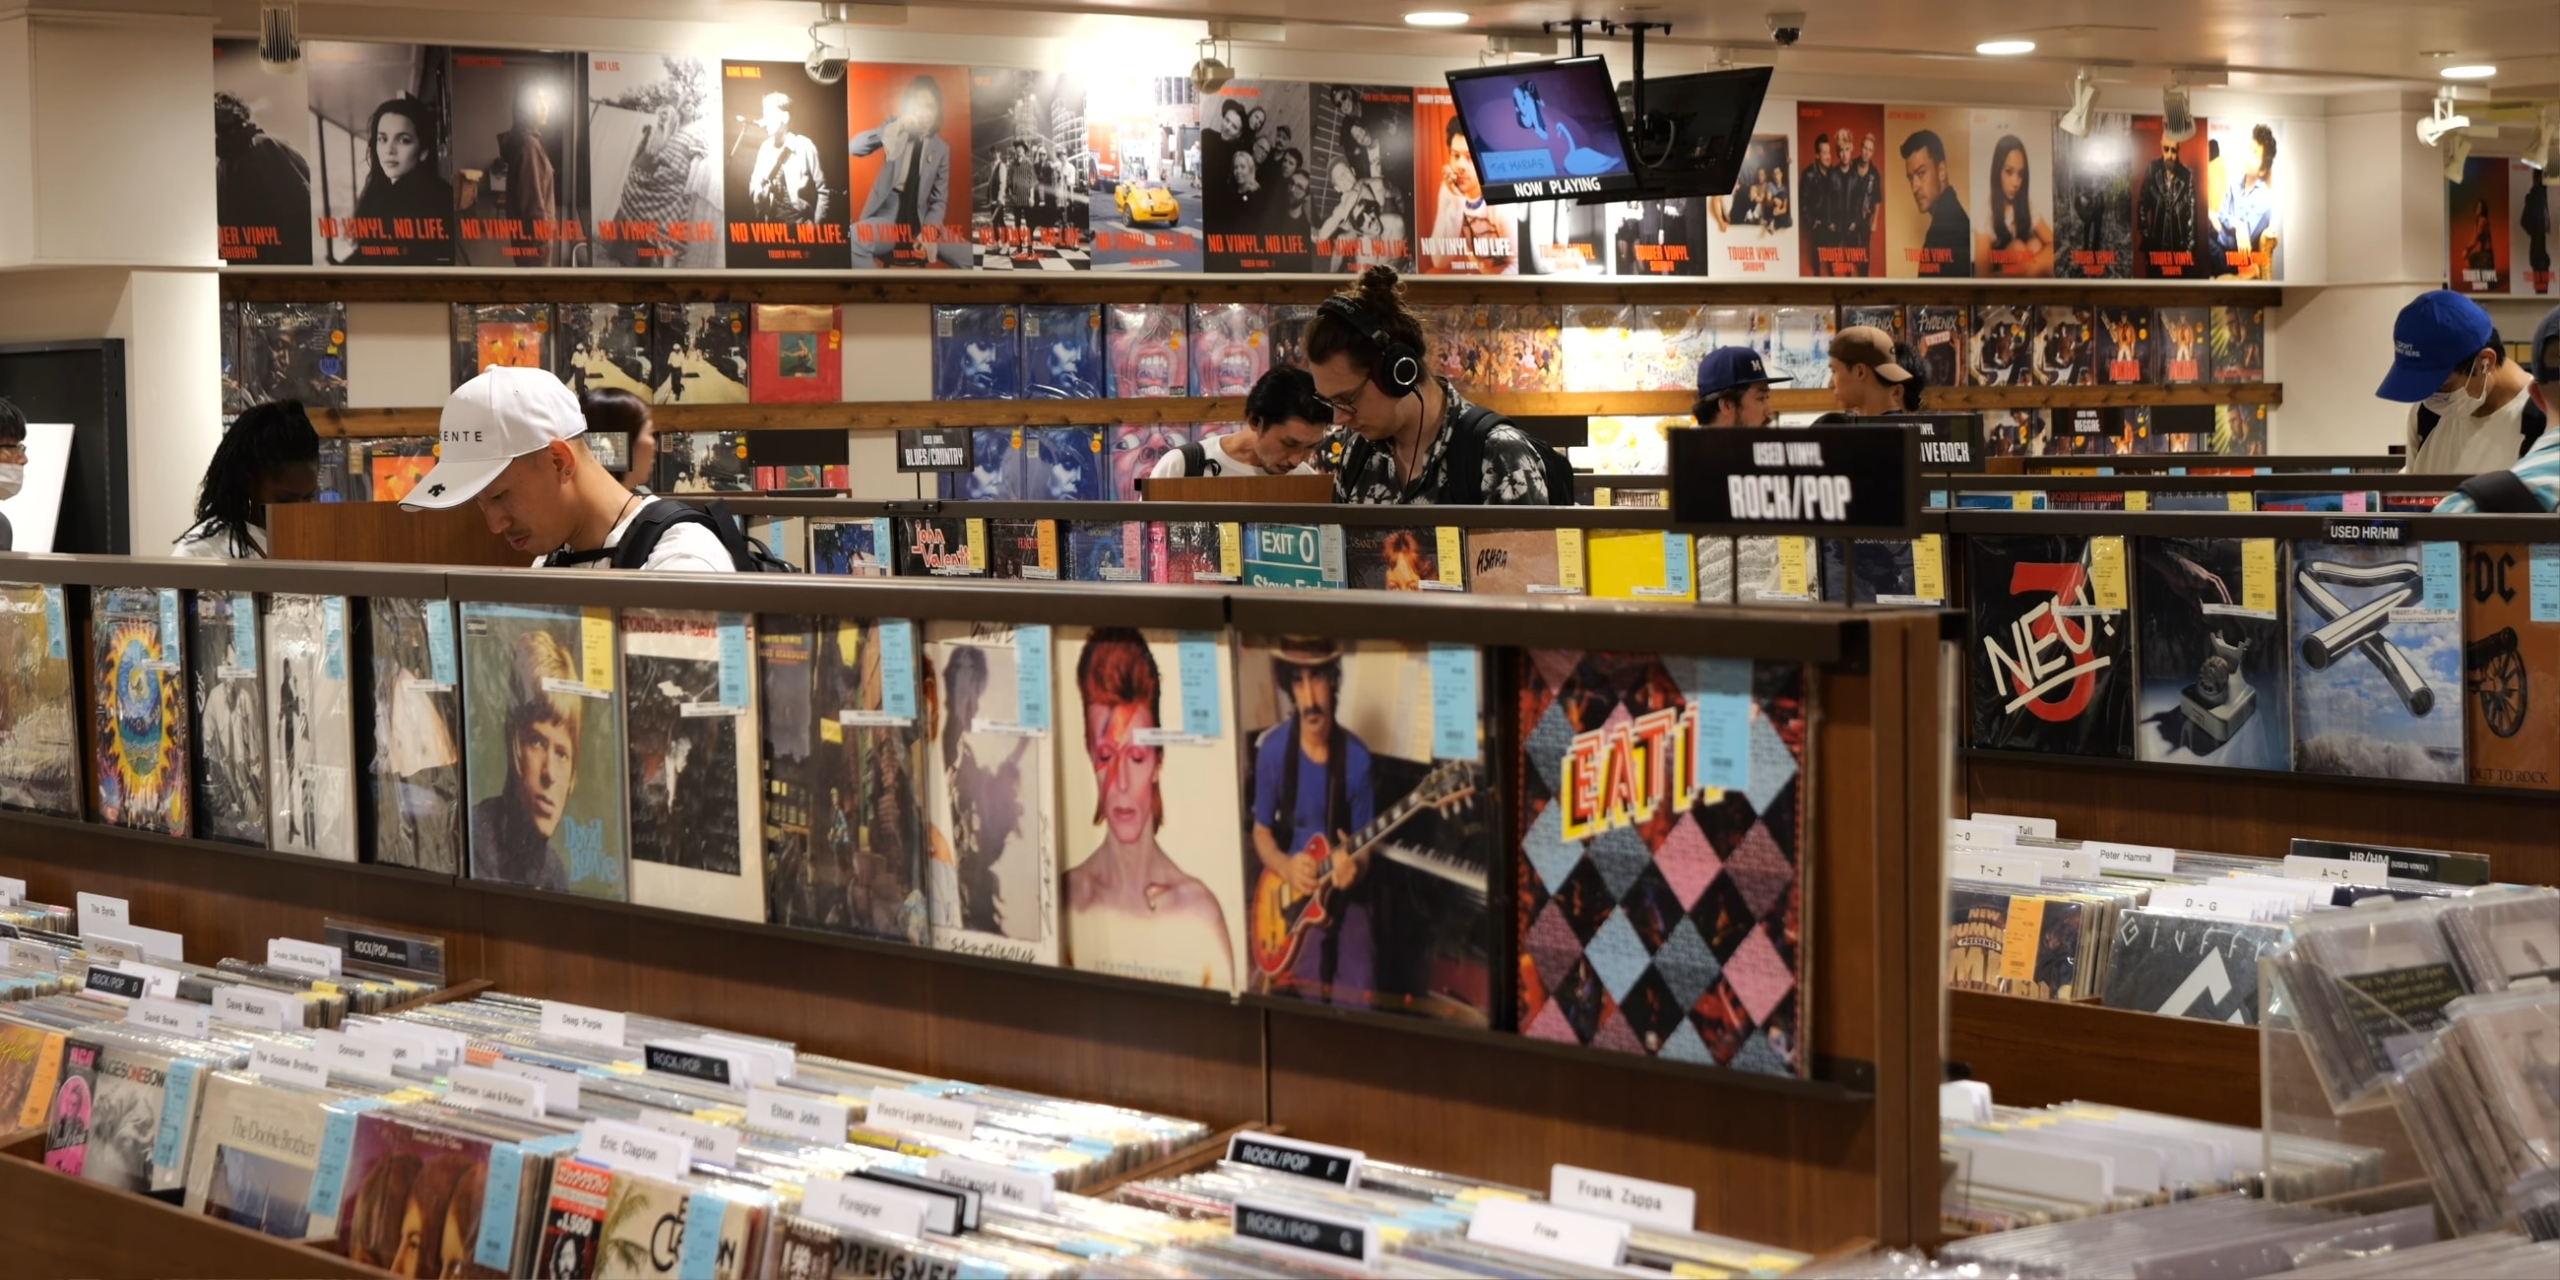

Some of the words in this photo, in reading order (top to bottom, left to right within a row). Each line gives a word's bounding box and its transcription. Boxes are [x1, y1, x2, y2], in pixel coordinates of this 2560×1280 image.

[1513, 181, 1543, 199] NOW
[1549, 176, 1602, 196] PLAYING
[242, 226, 281, 246] VINYL
[318, 217, 339, 238] NO
[342, 217, 392, 240] VINYL,
[393, 218, 416, 239] NO
[416, 218, 449, 240] LIFE.
[461, 219, 481, 240] NO
[533, 220, 551, 241] NO
[730, 222, 749, 243] NO
[751, 223, 796, 244] VINYL,
[797, 223, 815, 243] NO
[816, 223, 846, 244] LIFE.
[1207, 233, 1224, 253] NO
[1226, 234, 1264, 255] VINYL,
[1265, 234, 1283, 254] NO
[1283, 235, 1308, 254] LIFE.
[1421, 237, 1437, 255] NO
[1438, 238, 1473, 257] VINYL,
[1474, 238, 1489, 255] NO
[1489, 238, 1514, 256] LIFE.
[1635, 244, 1664, 261] TOWER
[1664, 245, 1690, 261] VINYL
[1727, 246, 1754, 261] TOWER
[1755, 247, 1780, 262] VINYL
[1818, 247, 1844, 262] TOWER
[1844, 247, 1869, 262] VINYL
[1904, 248, 1929, 262] TOWER
[1930, 248, 1954, 263] VINYL
[2150, 251, 2174, 266] TOWER
[2174, 251, 2194, 266] VINYL
[1918, 312, 1958, 332] PHOENIX
[905, 447, 964, 466] BLUES/COUNTRY
[1752, 441, 1785, 466] USED
[1785, 442, 1825, 467] VINYL
[1727, 474, 1853, 521] ROCK/POP
[2330, 525, 2360, 538] USED
[2362, 526, 2399, 540] HR/HM
[1261, 531, 1295, 555] EXIT
[2496, 768, 2513, 782] TO
[2515, 770, 2549, 784] ROCK
[563, 815, 603, 850] David
[2018, 825, 2033, 836] Tull
[570, 848, 621, 882] Bowie
[2100, 849, 2120, 861] Peter
[2123, 851, 2152, 863] Hammill
[2349, 851, 2389, 865] HR/HM
[91, 903, 100, 915] The
[101, 905, 116, 918] Byrds
[1968, 907, 2000, 922] NEW
[354, 940, 389, 958] ROCK/POP
[1961, 938, 2000, 951] PRESENTS
[90, 972, 125, 989] ROCK/POP
[132, 980, 139, 993] D
[226, 998, 242, 1011] Dave
[244, 1001, 266, 1016] Mason
[144, 1011, 161, 1024] David
[161, 1014, 179, 1027] Bowie
[561, 1013, 579, 1028] Deep
[581, 1016, 603, 1032] Purple
[255, 1049, 269, 1063] The
[269, 1053, 291, 1069] Doobie
[291, 1057, 319, 1074] Brothers
[652, 1051, 702, 1073] ROCK/POP
[713, 1063, 722, 1077] E
[232, 1115, 248, 1134] The
[770, 1105, 794, 1121] Elton
[798, 1111, 821, 1127] John
[877, 1104, 903, 1121] Electric
[905, 1111, 925, 1127] Light
[925, 1115, 965, 1132] Orchestra
[600, 1135, 618, 1152] Eric
[621, 1140, 658, 1161] Clapton
[1242, 1144, 1310, 1172] ROCK/POP
[1327, 1161, 1338, 1178] F
[1001, 1185, 1025, 1203] Mac
[1577, 1179, 1614, 1202] Frank
[1620, 1187, 1664, 1212] Zappa
[838, 1193, 884, 1219] Foreigner
[1245, 1211, 1320, 1245] ROCK/POP
[1340, 1233, 1353, 1252] G
[1533, 1221, 1560, 1241] Free
